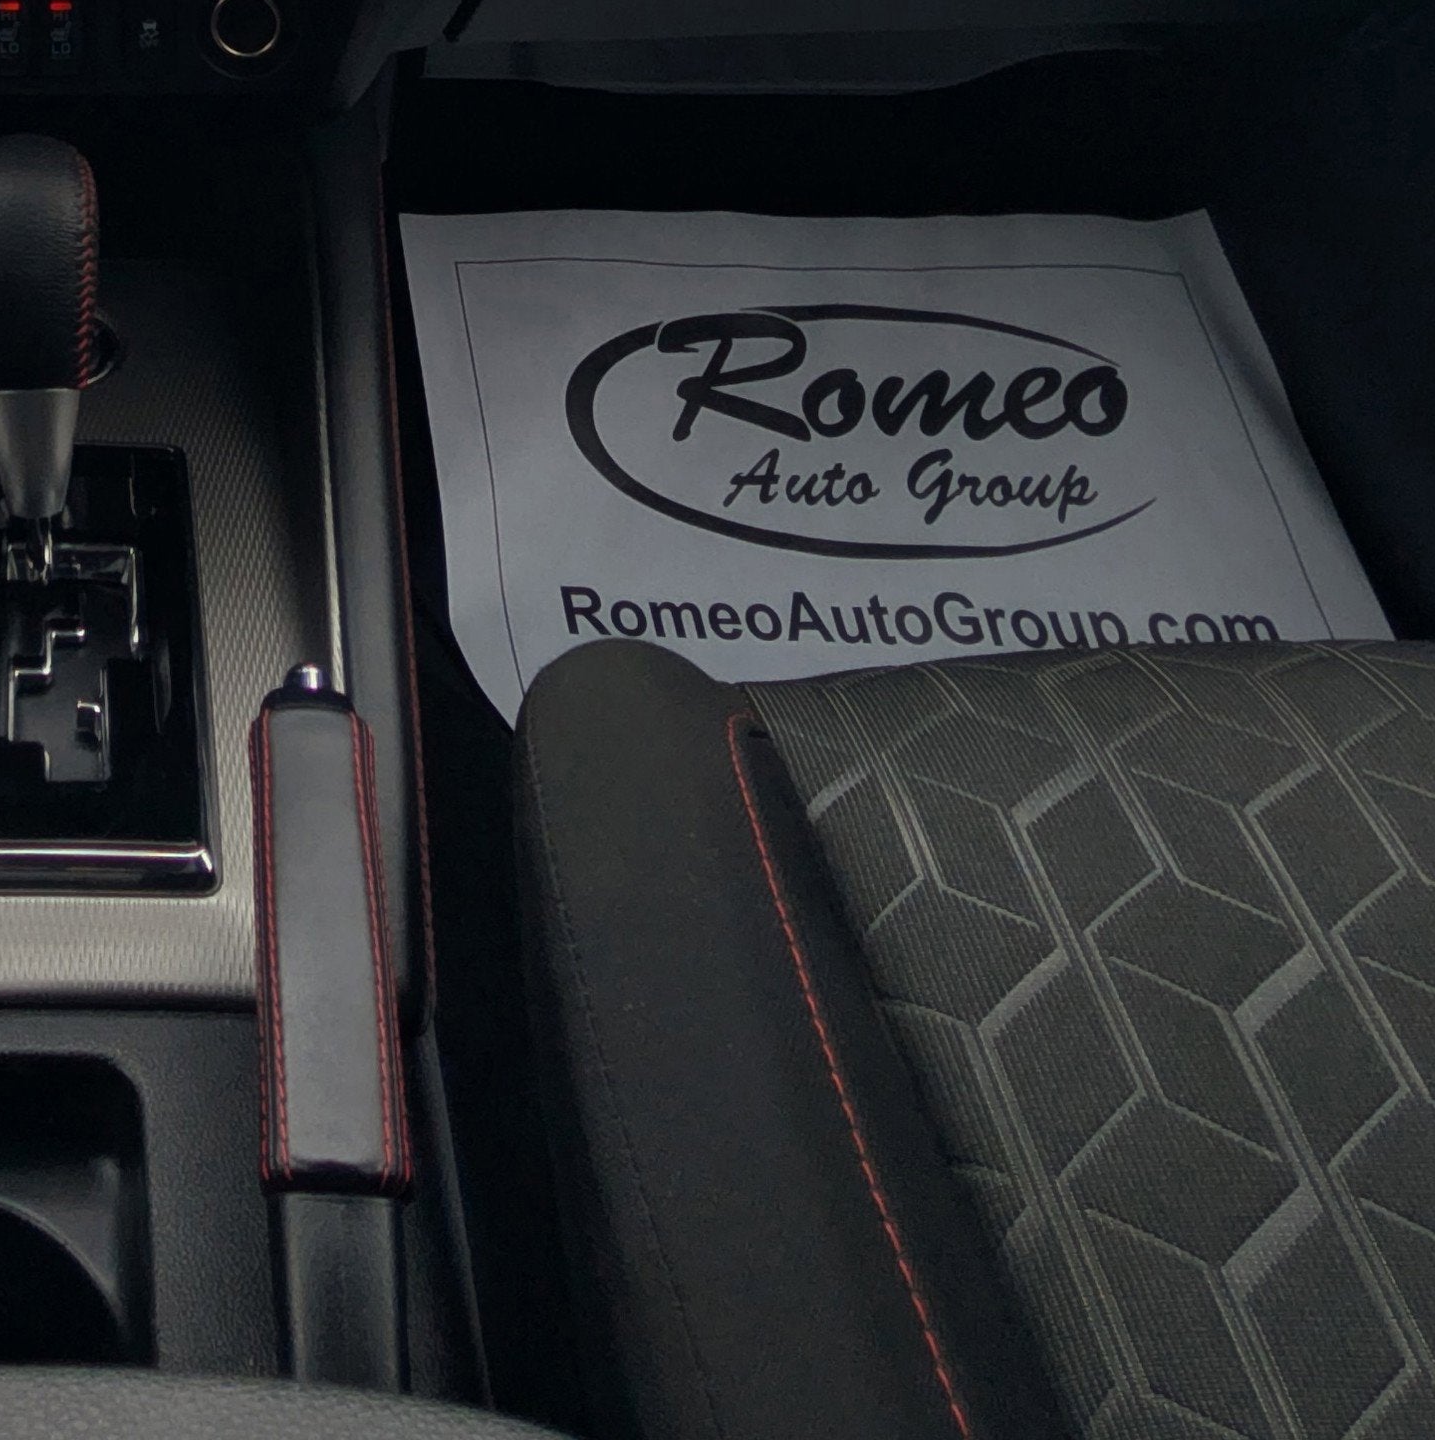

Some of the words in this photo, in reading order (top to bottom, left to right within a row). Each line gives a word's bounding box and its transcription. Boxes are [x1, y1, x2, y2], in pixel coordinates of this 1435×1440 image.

[0, 41, 20, 55] LO
[51, 41, 72, 55] LO
[654, 309, 1131, 443] Romeo
[721, 446, 882, 510] Auto
[903, 446, 1099, 525] Group
